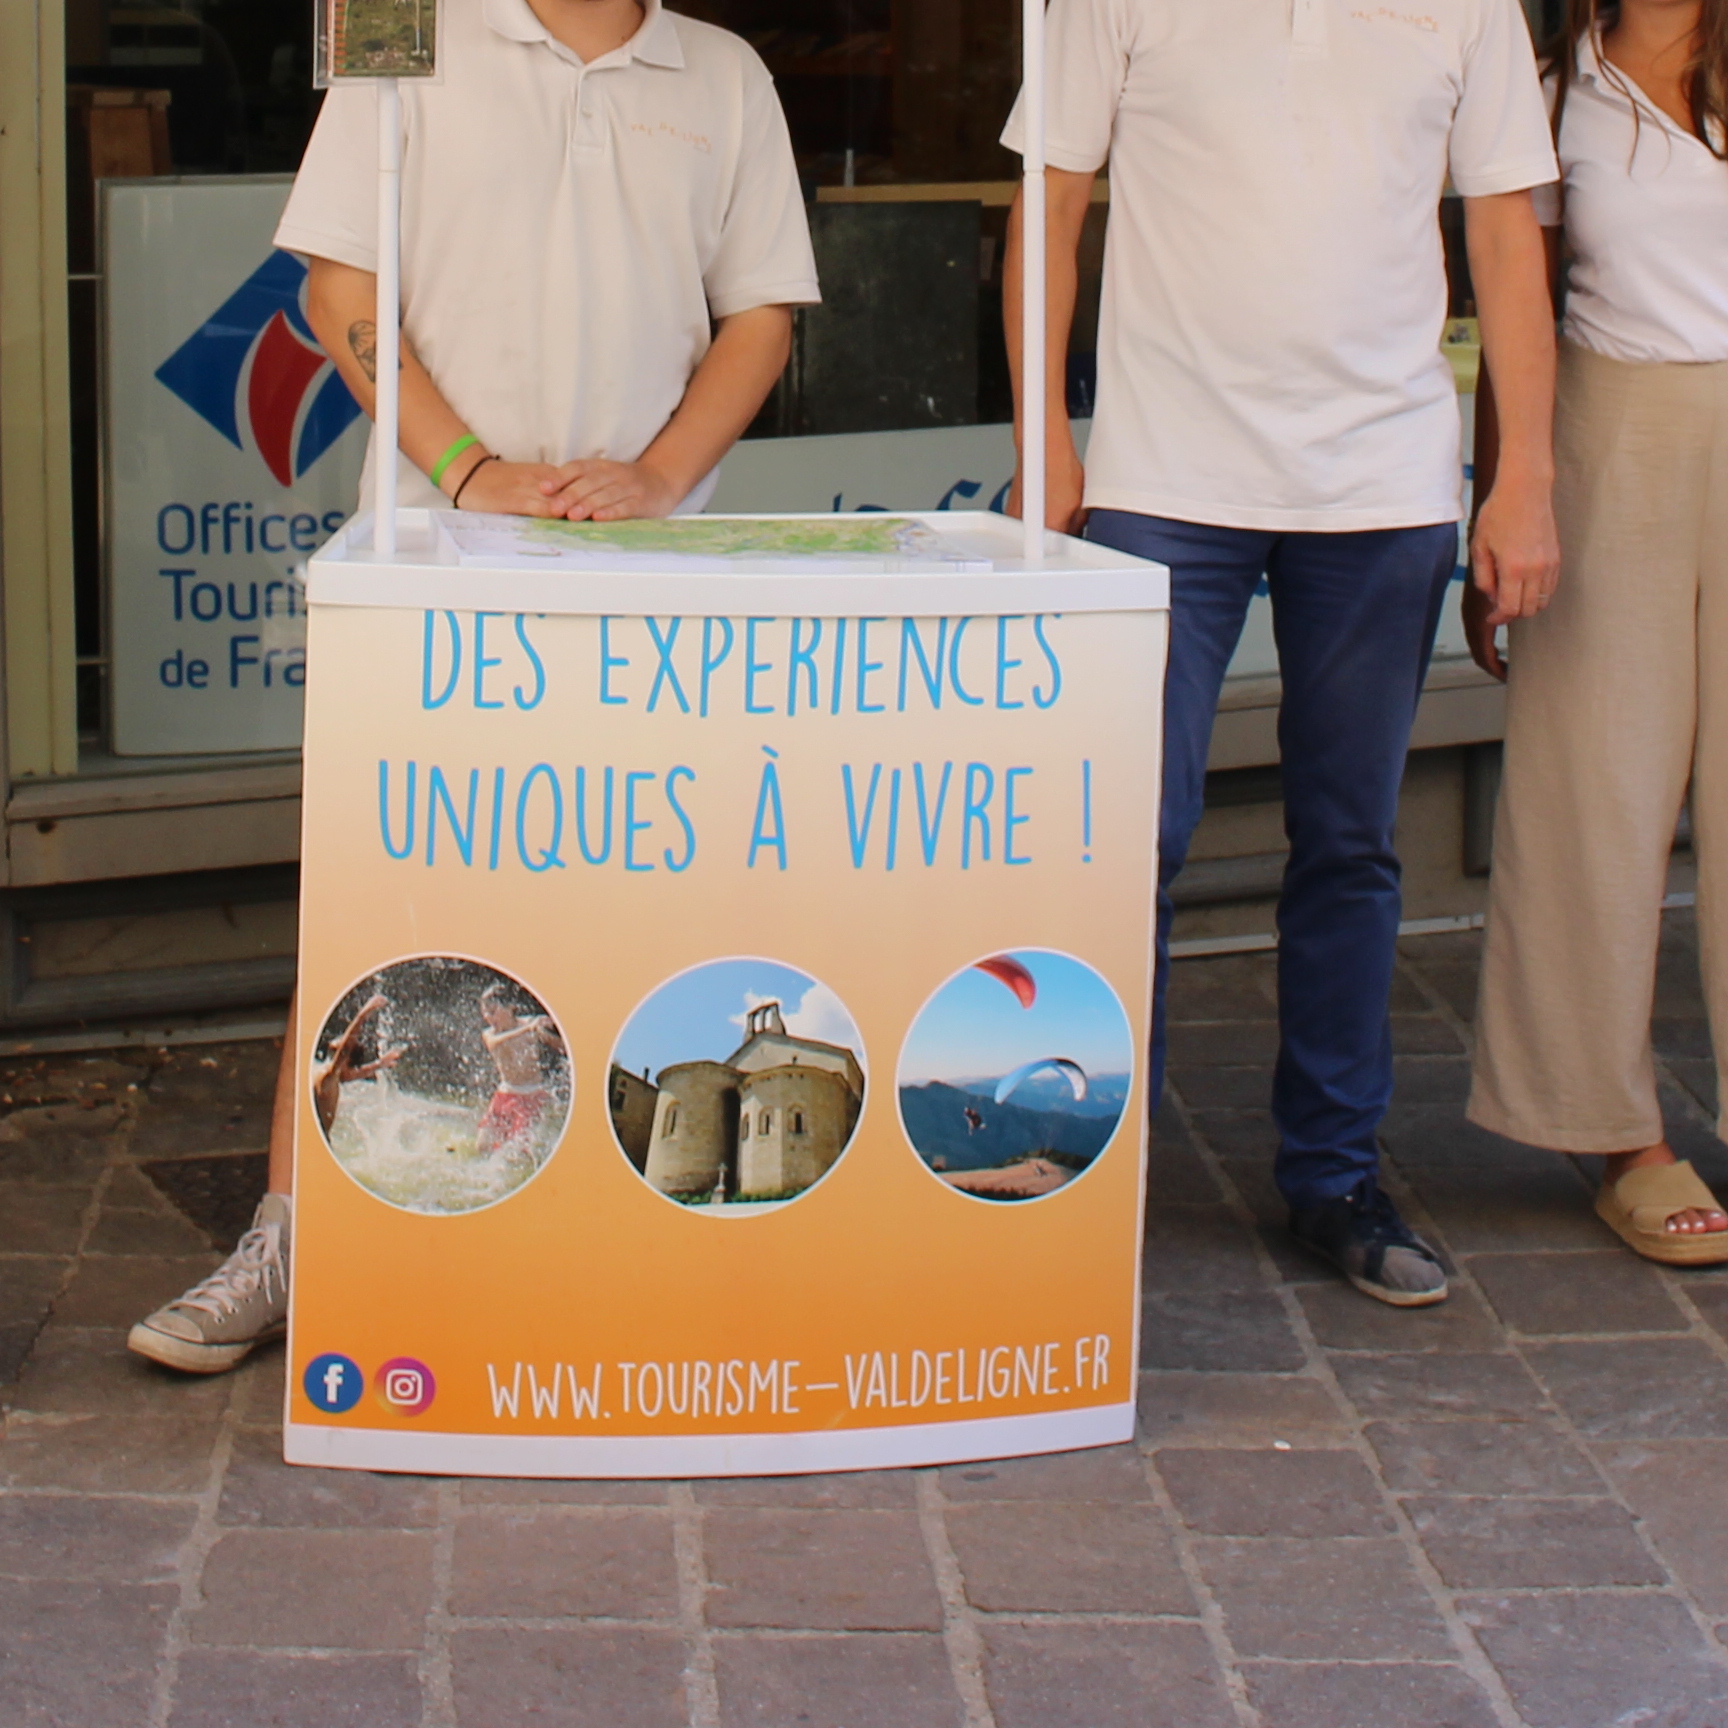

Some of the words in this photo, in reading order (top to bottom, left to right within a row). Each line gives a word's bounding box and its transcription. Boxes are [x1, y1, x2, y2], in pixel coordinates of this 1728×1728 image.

[158, 566, 306, 622] Touri
[159, 649, 210, 689] de
[229, 635, 306, 689] Fra
[421, 609, 546, 711] DES
[378, 759, 697, 872] UNIQUES
[746, 743, 787, 871] À
[840, 760, 1035, 872] VIVRE
[1082, 758, 1093, 864] !
[486, 1333, 1111, 1421] WWW.TOURISME-VALDELIGNE.FR
